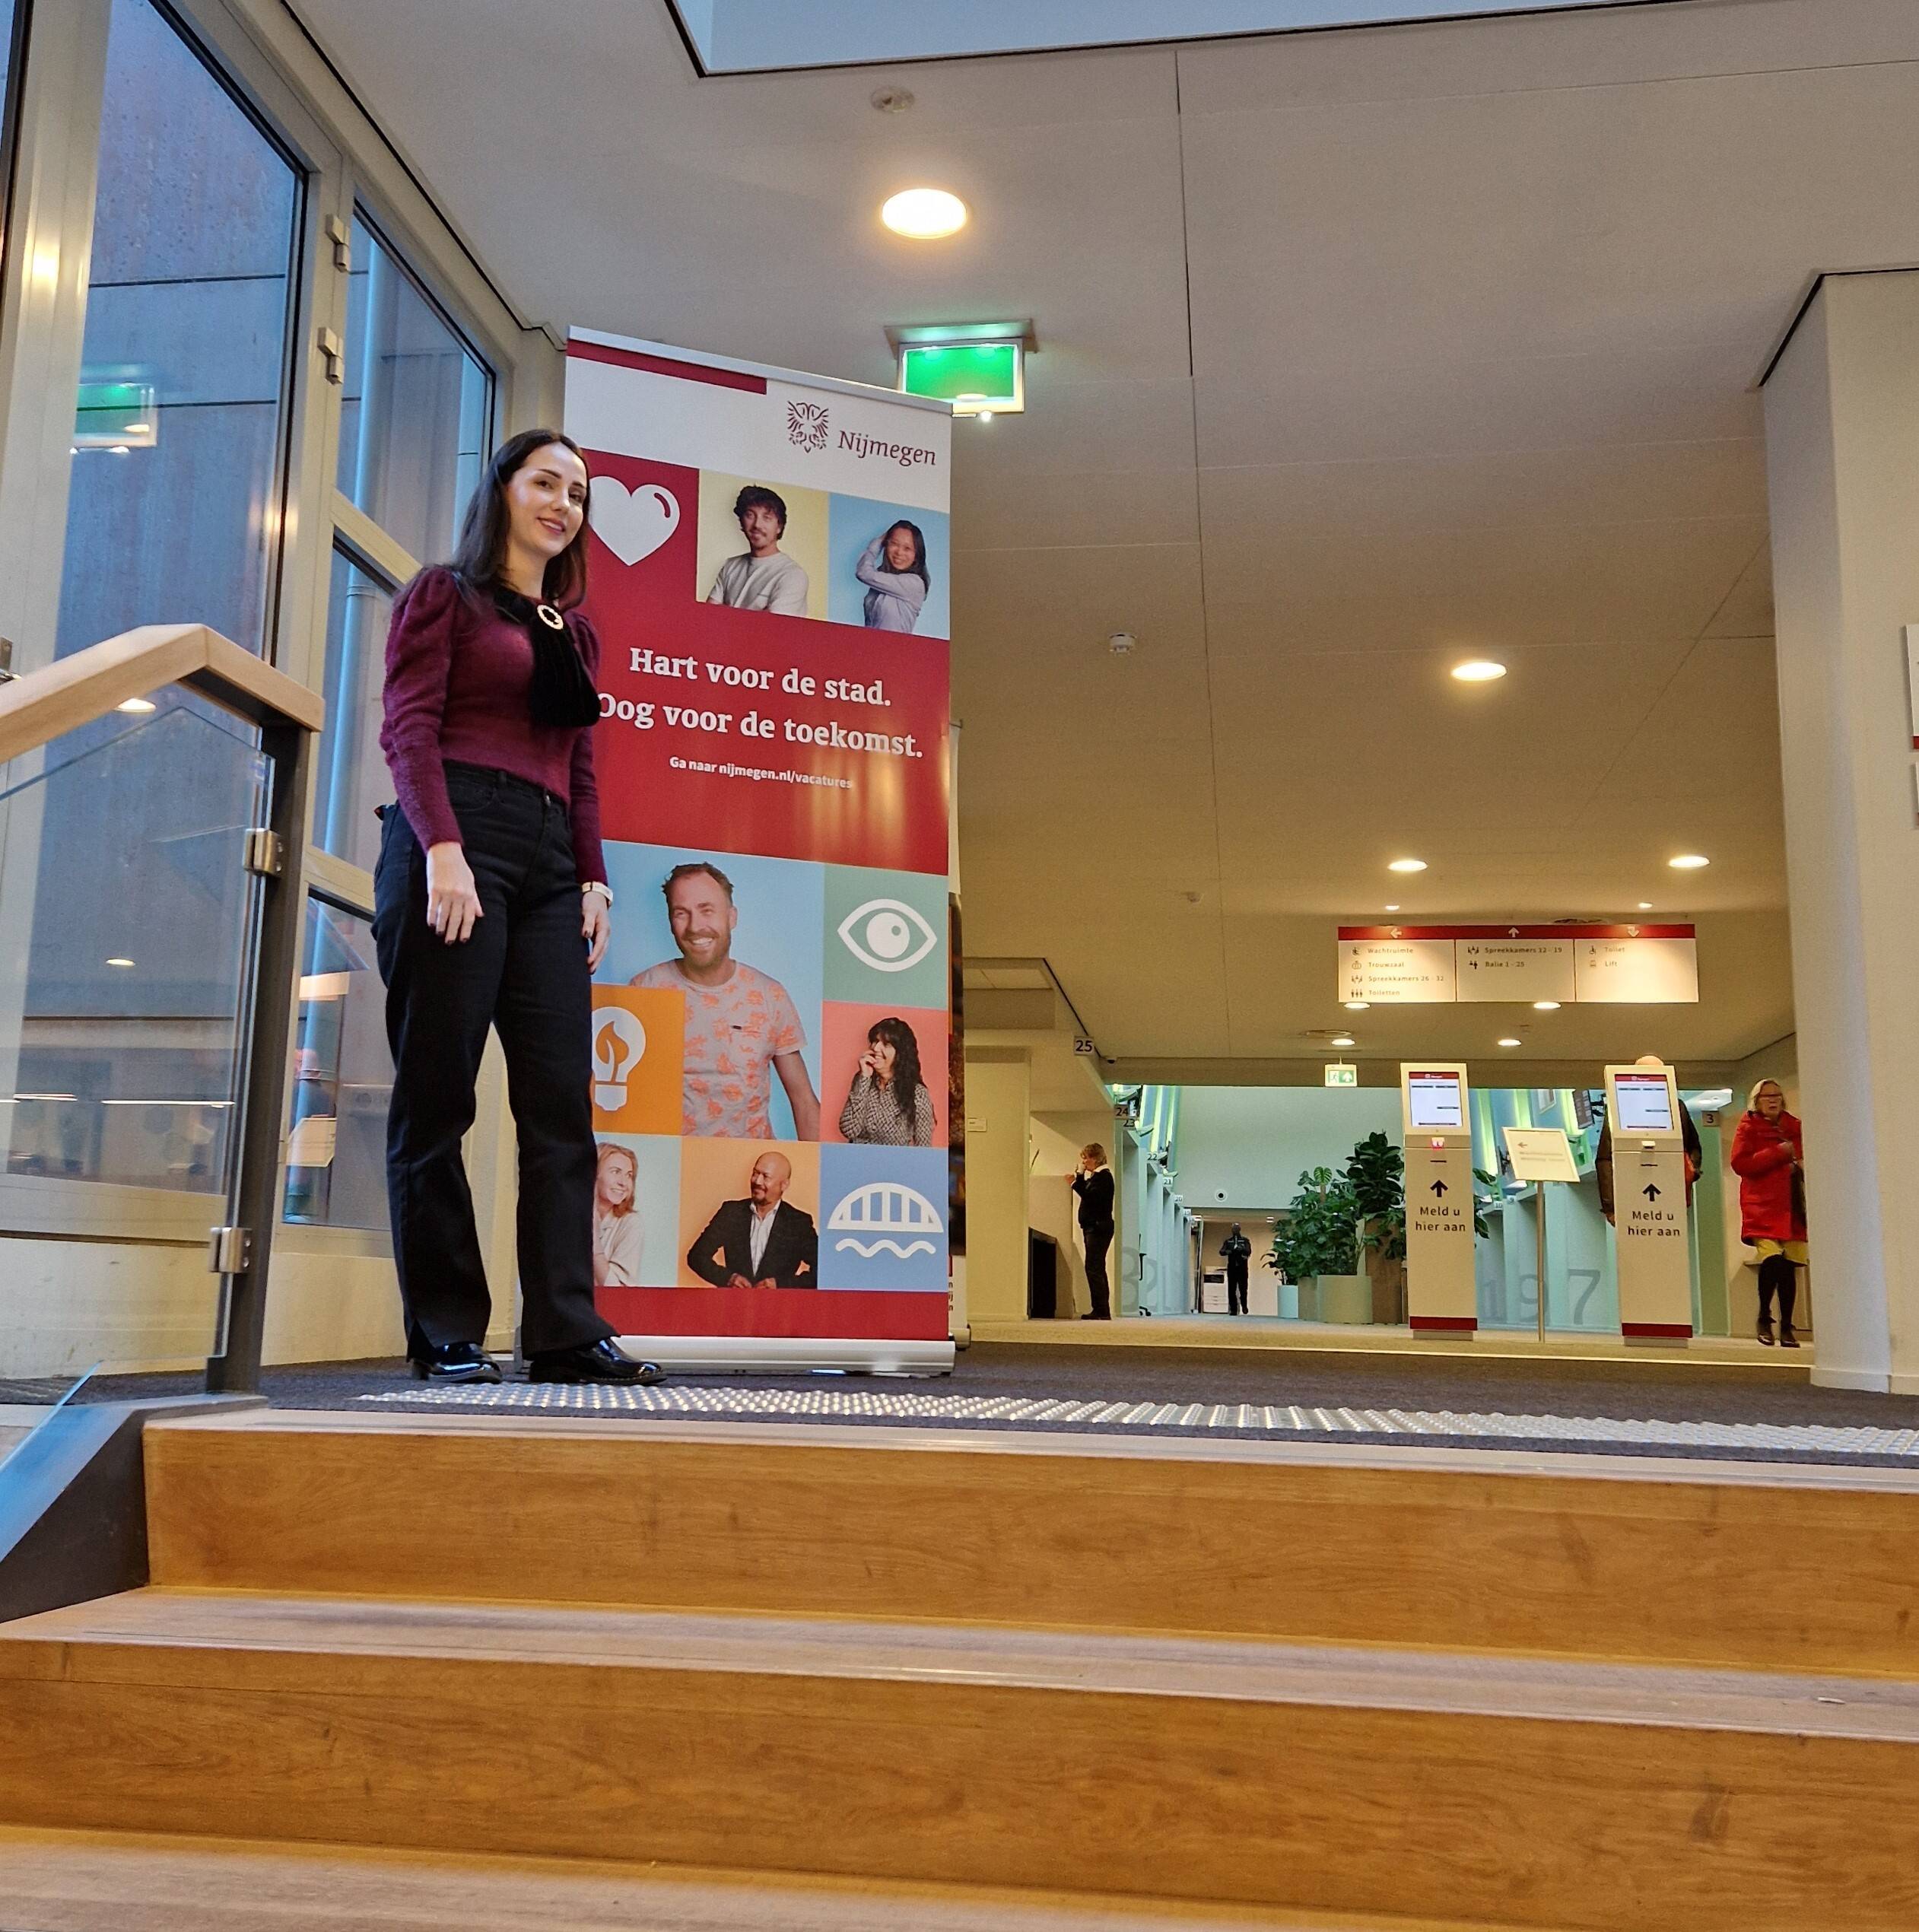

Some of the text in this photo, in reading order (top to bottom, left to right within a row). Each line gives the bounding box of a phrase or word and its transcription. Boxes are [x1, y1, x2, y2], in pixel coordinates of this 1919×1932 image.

[837, 430, 936, 466] Nijmegen
[630, 647, 891, 707] Hart voor de stad.
[598, 692, 923, 758] Oog voor de toekomst.
[669, 756, 853, 789] Ga naar nijmegen.nl/vacatures
[1075, 1040, 1093, 1052] 25
[1116, 1107, 1128, 1116] 24
[1123, 1118, 1135, 1127] 23
[1706, 1114, 1714, 1123] 3
[1419, 1206, 1449, 1216] Meld
[1632, 1210, 1662, 1221] Meld
[1415, 1221, 1466, 1231] hier aan
[1628, 1225, 1653, 1235] hier
[1568, 1269, 1601, 1325] 7
